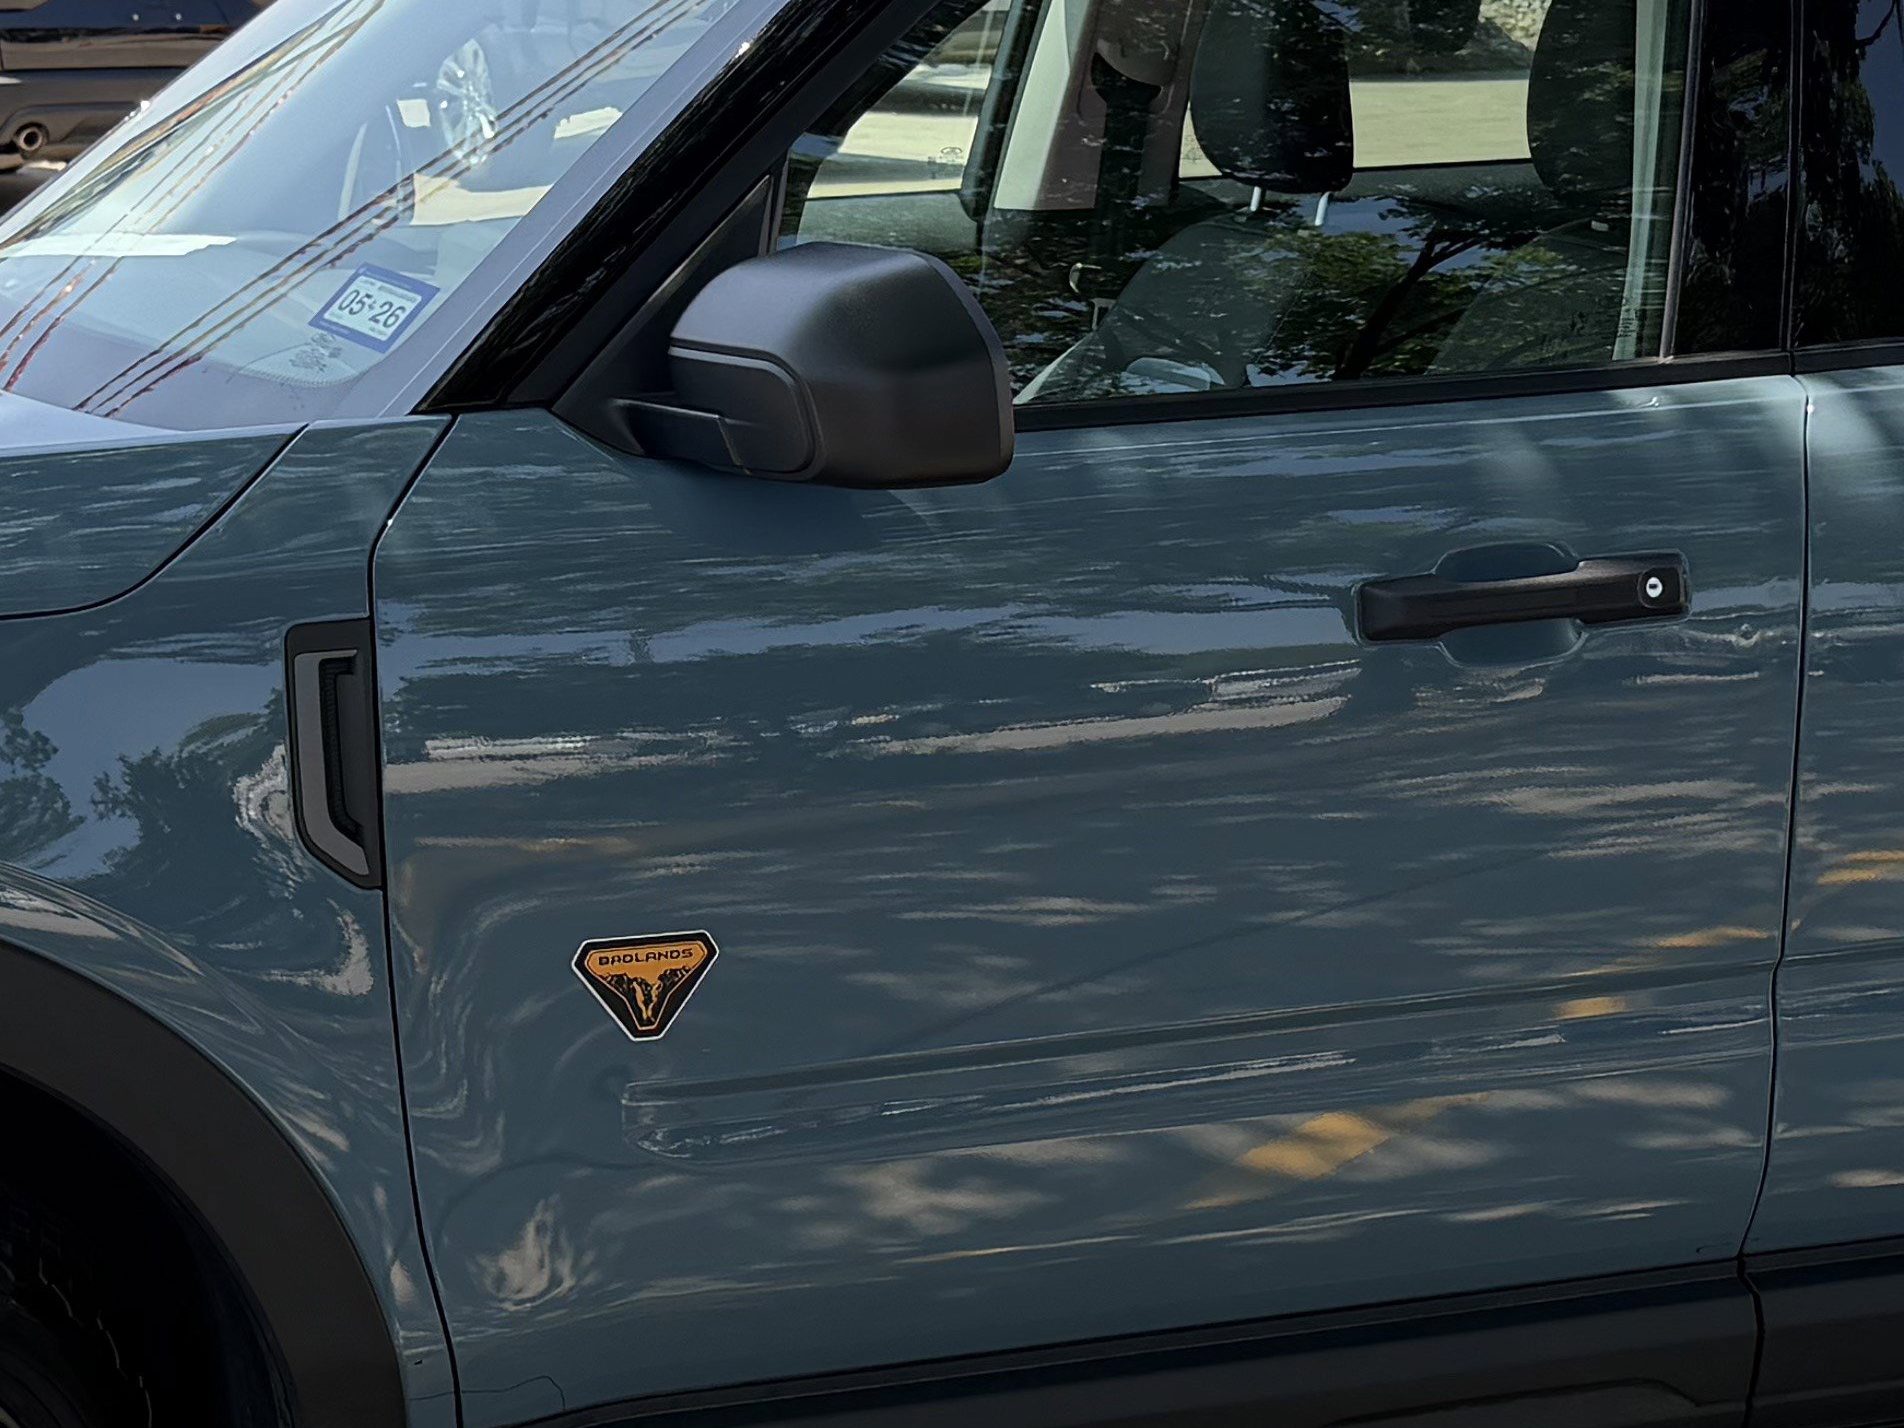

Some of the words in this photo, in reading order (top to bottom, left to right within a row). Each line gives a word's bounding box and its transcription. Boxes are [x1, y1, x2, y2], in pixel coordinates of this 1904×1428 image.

[337, 289, 374, 316] 05
[368, 301, 406, 329] 26
[598, 947, 694, 966] BADLANDS
